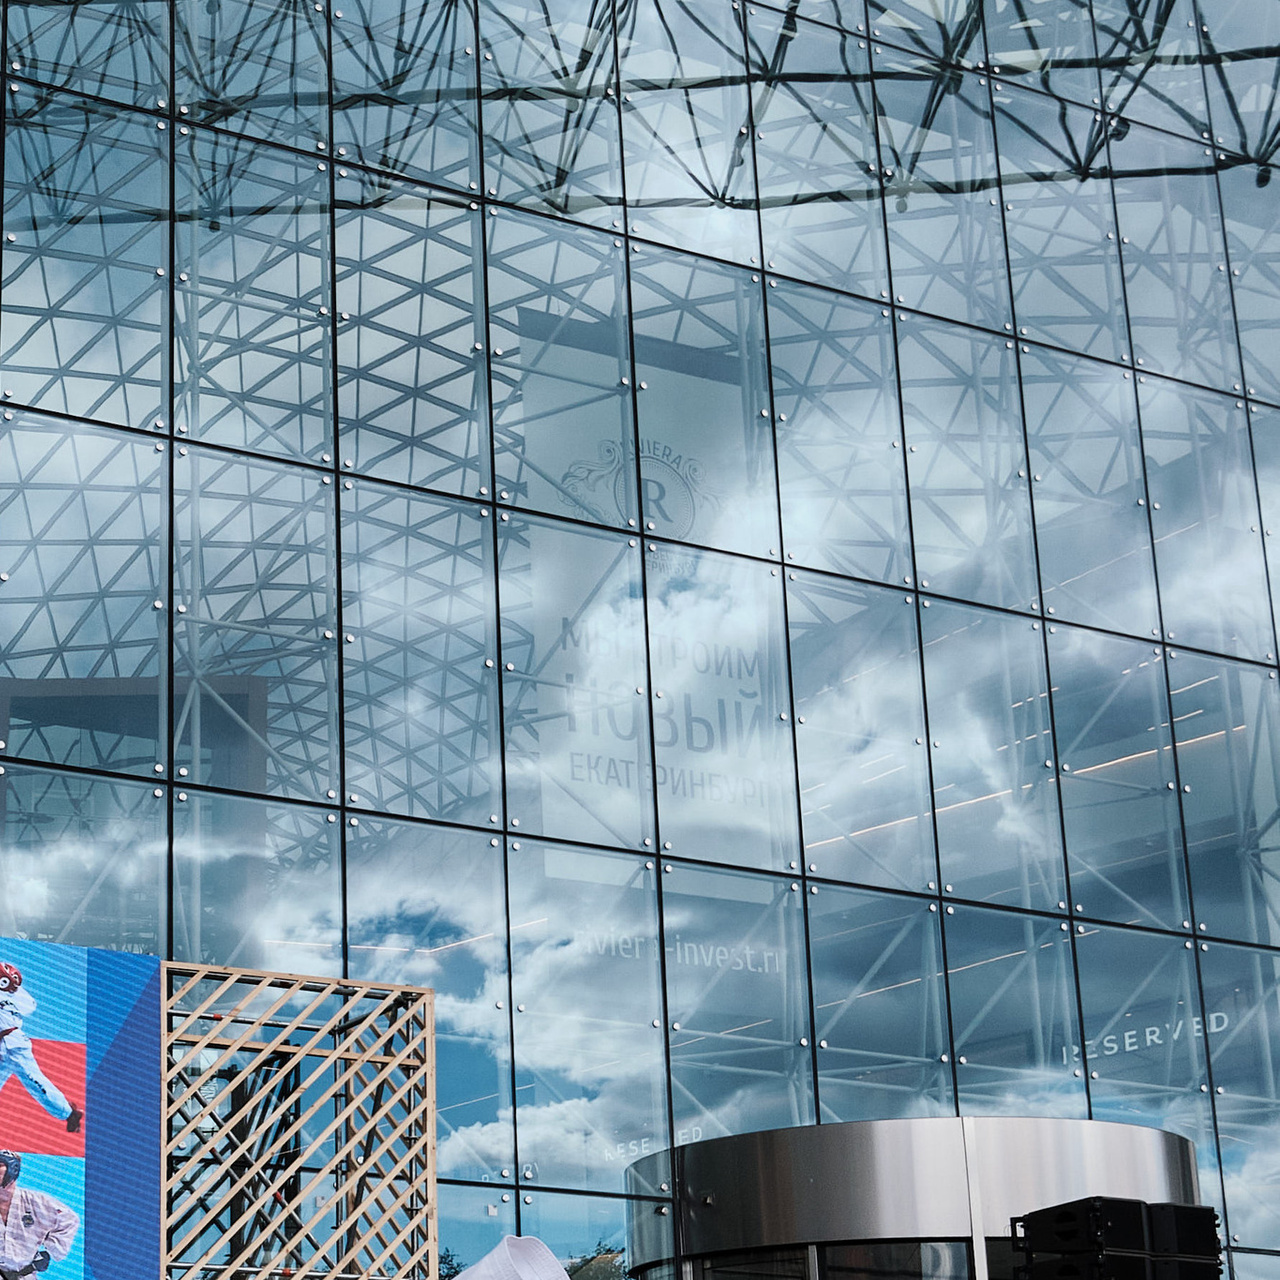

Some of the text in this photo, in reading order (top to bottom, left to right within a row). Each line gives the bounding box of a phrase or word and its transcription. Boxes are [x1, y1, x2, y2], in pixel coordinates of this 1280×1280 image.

[641, 477, 674, 523] R
[634, 632, 764, 680] ТРОИМ
[565, 672, 768, 762] НОВЫЙ
[1062, 1011, 1230, 1066] RESERVED
